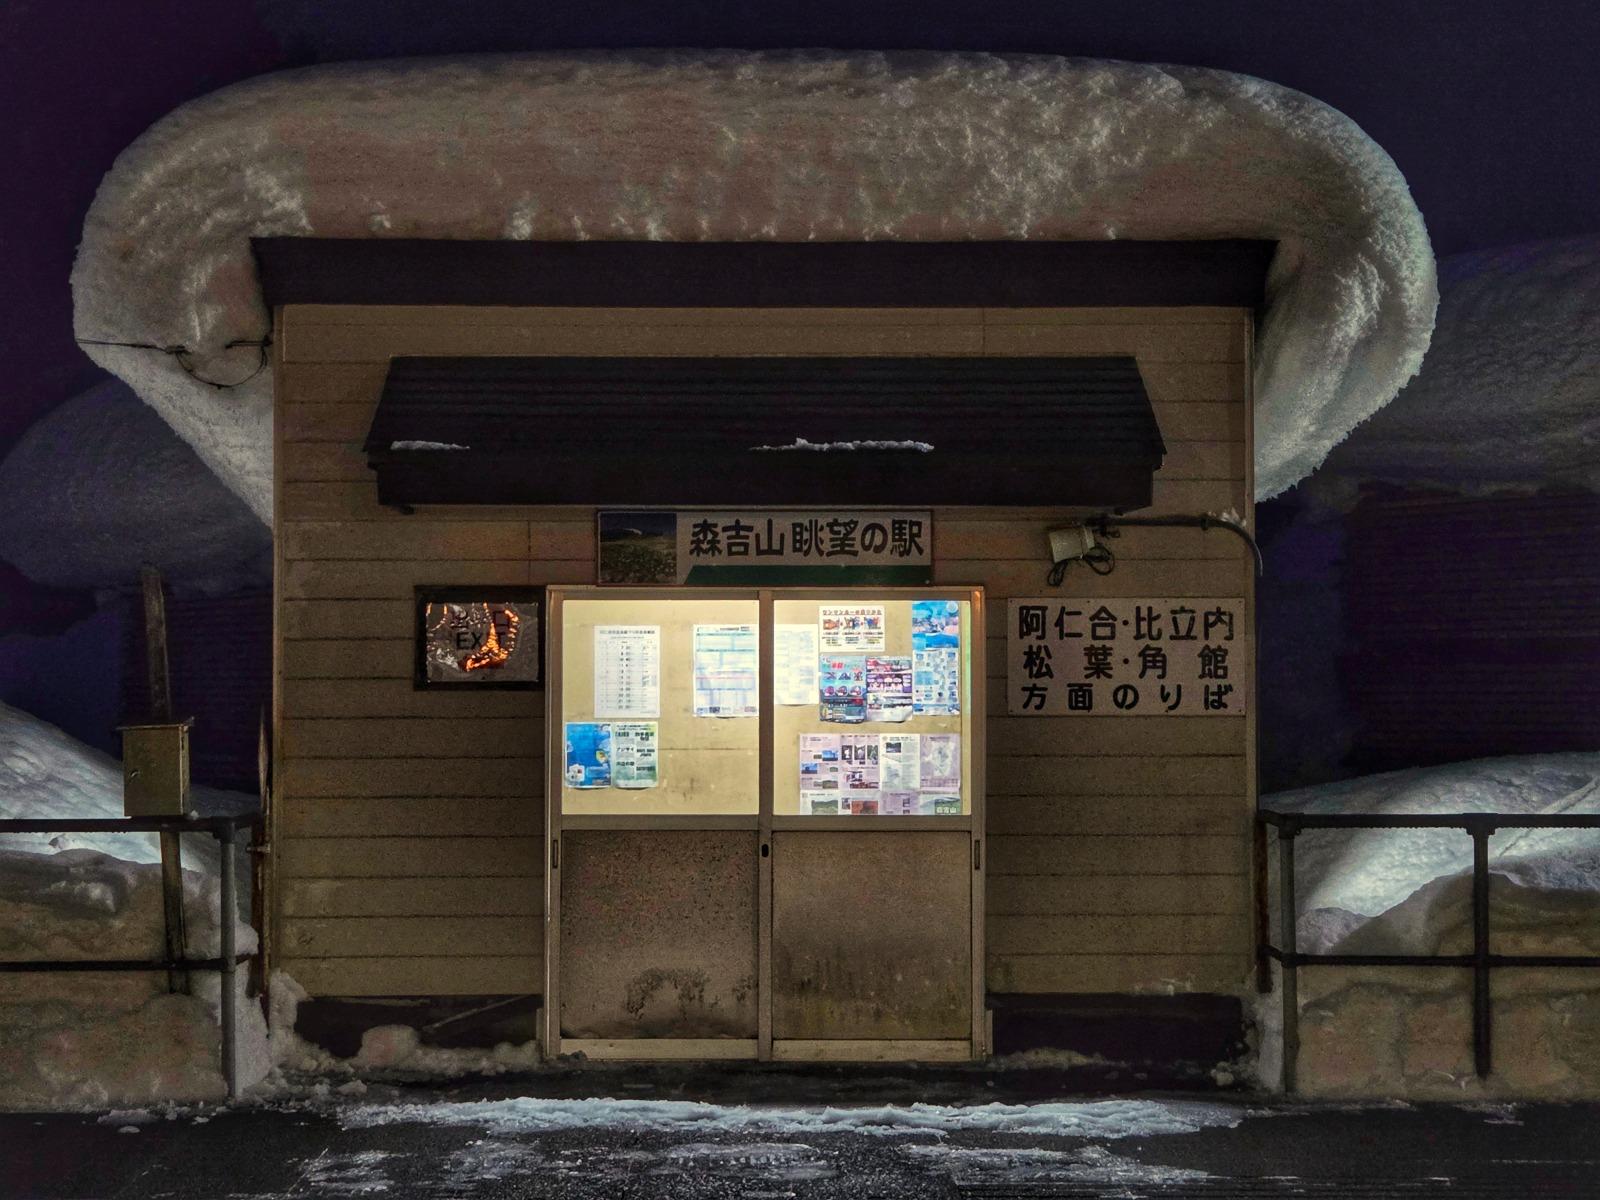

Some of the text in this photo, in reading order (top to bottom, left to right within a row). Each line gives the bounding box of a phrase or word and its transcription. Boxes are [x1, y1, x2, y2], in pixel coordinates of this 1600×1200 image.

[457, 632, 506, 650] EXT
[1021, 682, 1234, 711] 方面のりば
